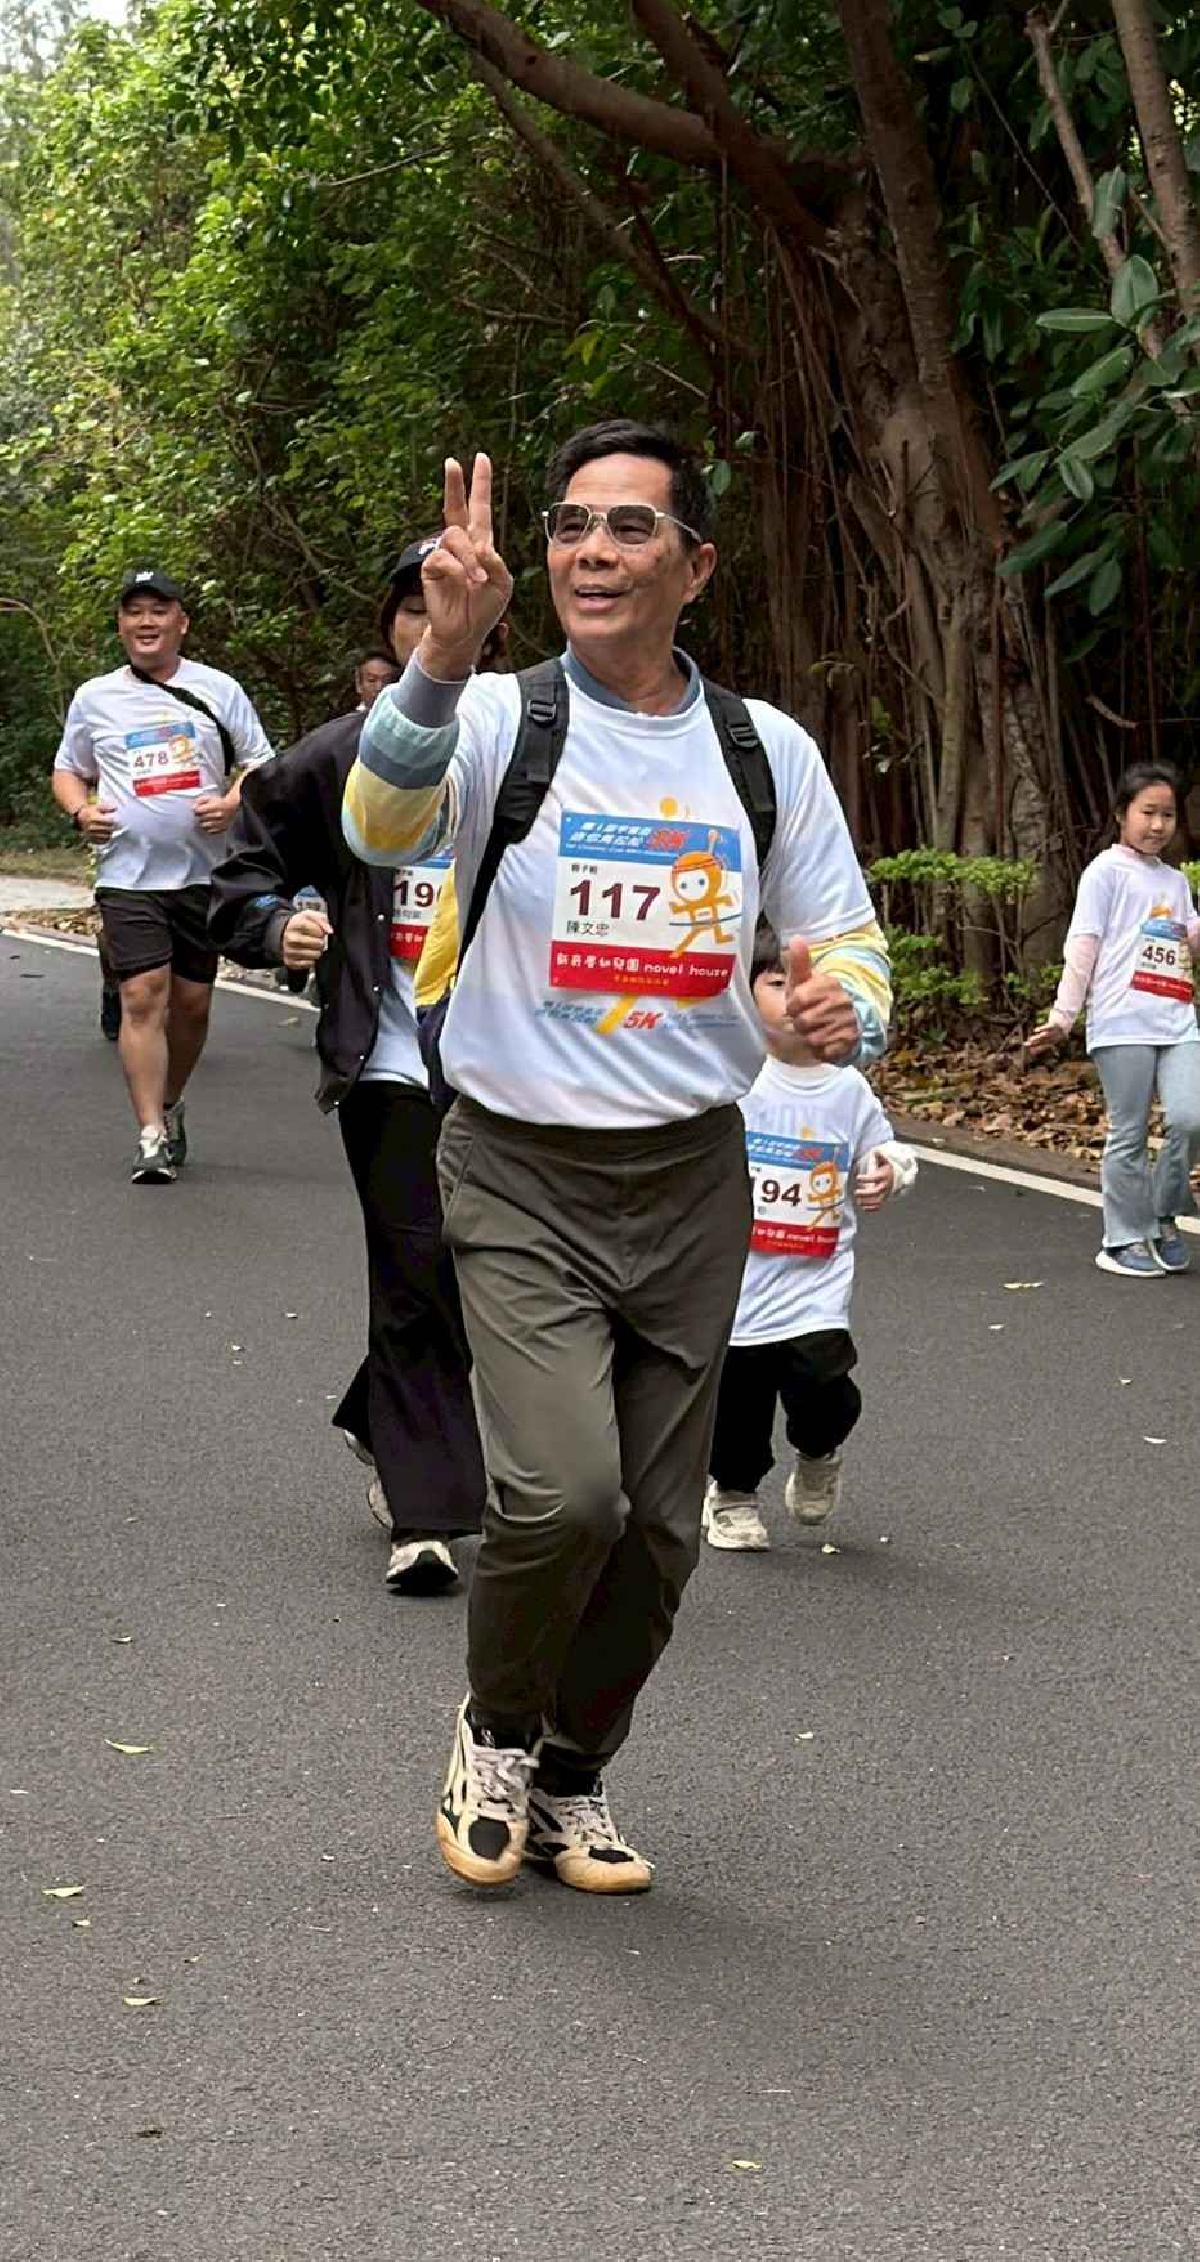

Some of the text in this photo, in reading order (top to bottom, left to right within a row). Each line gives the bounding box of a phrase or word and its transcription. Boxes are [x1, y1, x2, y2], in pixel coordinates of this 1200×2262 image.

[134, 751, 169, 768] 478
[392, 880, 442, 907] 19
[570, 879, 661, 921] 117
[1142, 946, 1176, 966] 456
[644, 964, 684, 975] novel
[623, 1010, 665, 1029] 5K
